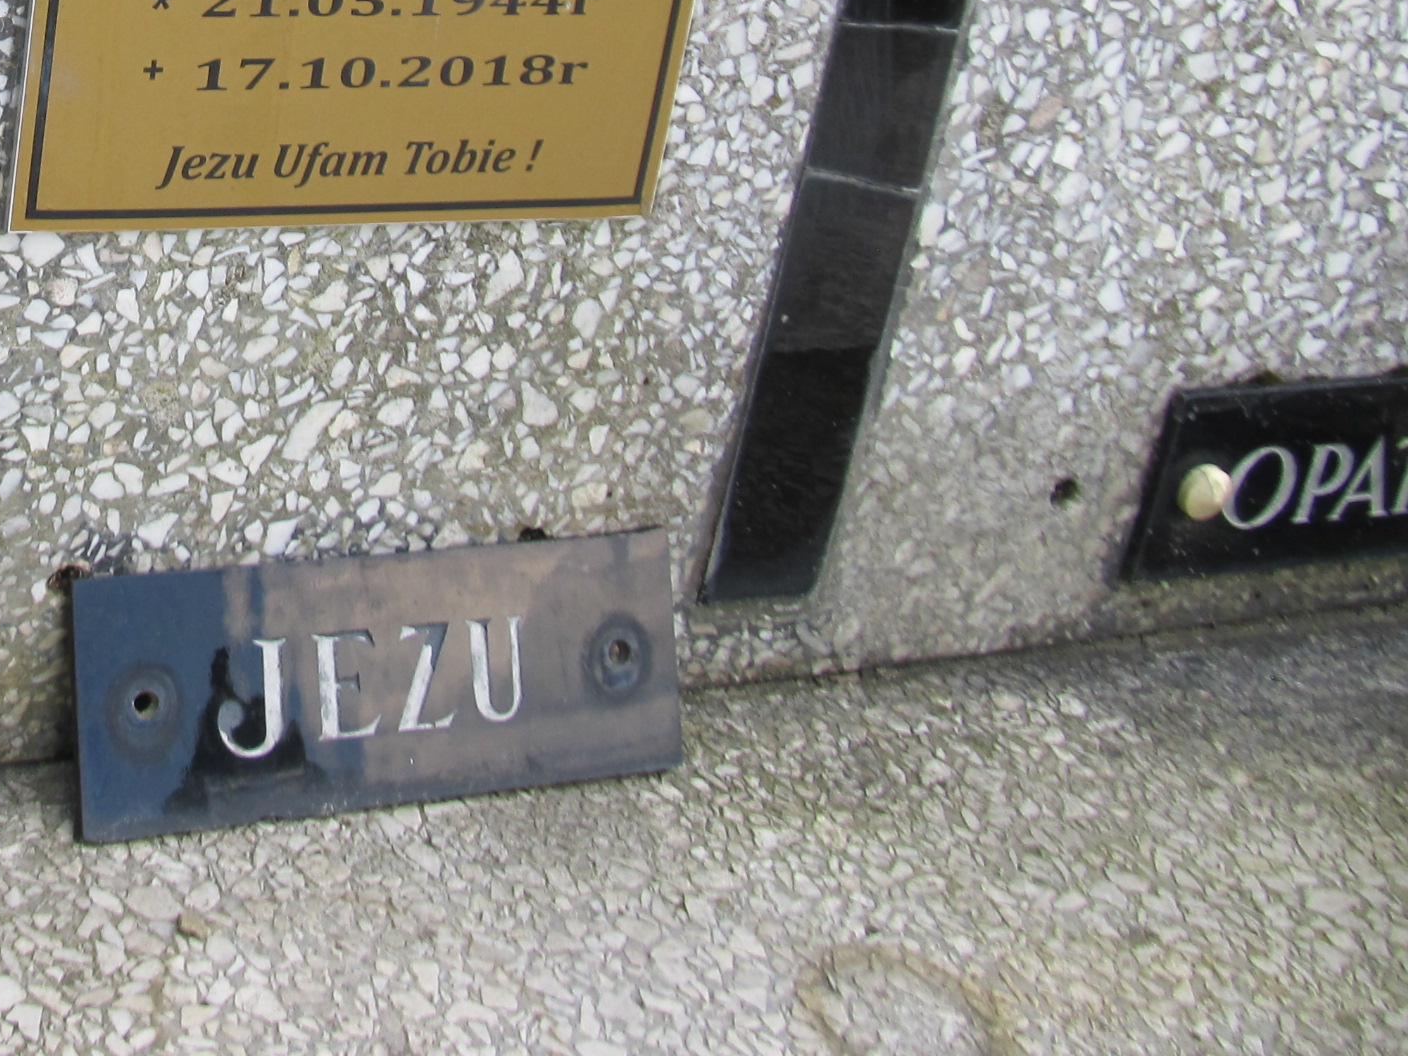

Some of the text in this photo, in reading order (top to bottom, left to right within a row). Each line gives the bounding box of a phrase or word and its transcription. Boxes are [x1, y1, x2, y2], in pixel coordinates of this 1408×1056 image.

[196, 54, 588, 91] 17.10.2018r
[155, 144, 259, 190] Jezu
[273, 141, 388, 188] Ufam
[403, 138, 516, 175] Tobie
[1222, 434, 1408, 530] OPA
[216, 615, 523, 759] JEZU
